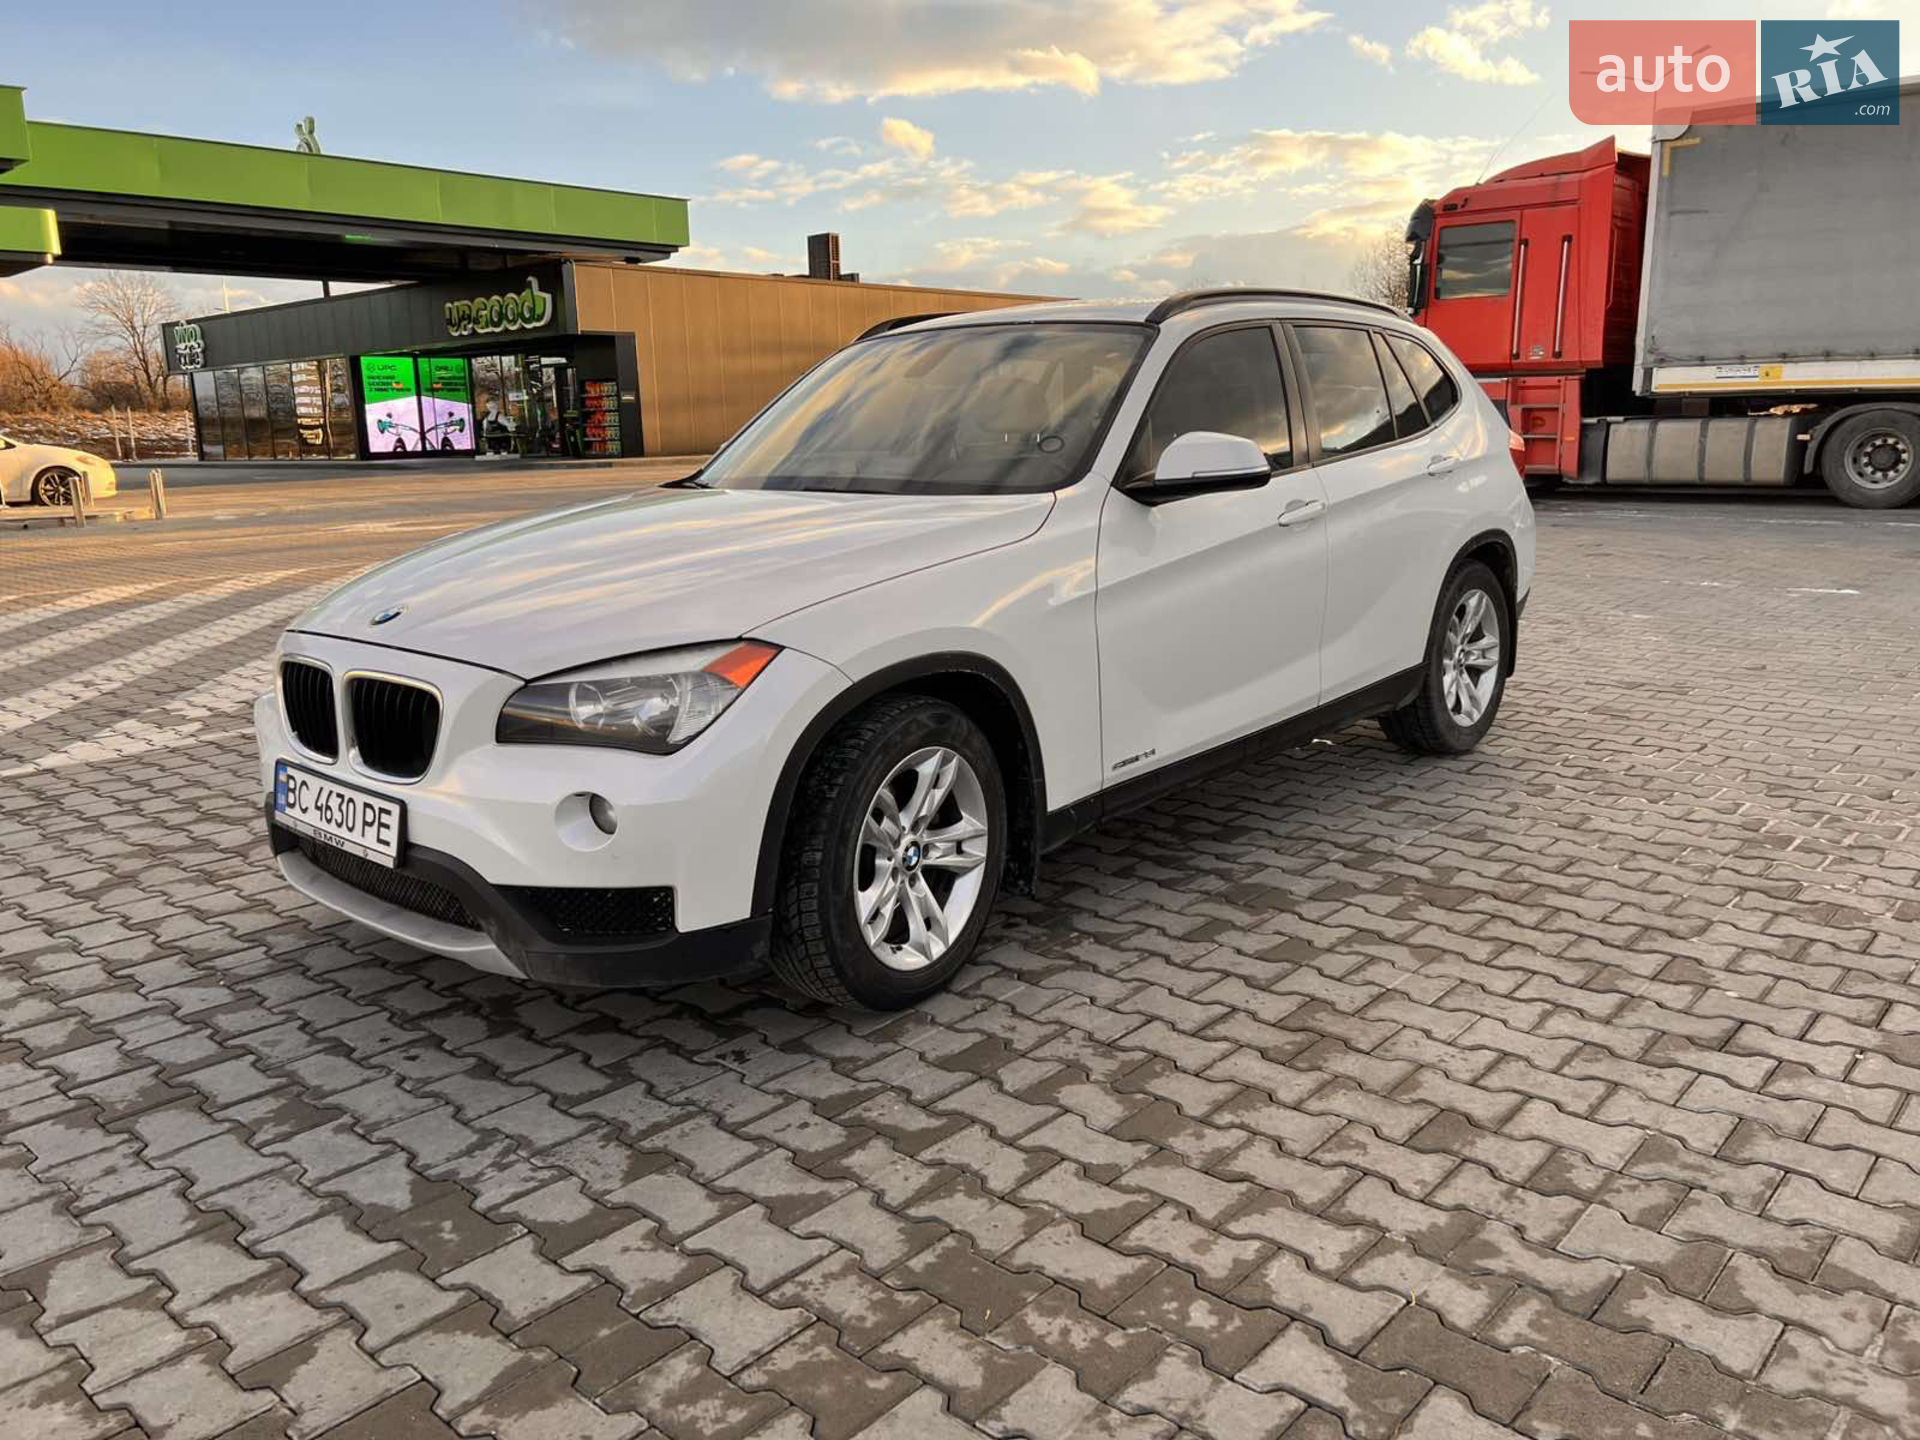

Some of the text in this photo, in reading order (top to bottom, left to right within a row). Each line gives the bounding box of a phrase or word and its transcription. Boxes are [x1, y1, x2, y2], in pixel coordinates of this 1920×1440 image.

[286, 774, 392, 847] BC 4630 PE
[312, 829, 346, 849] BMW
